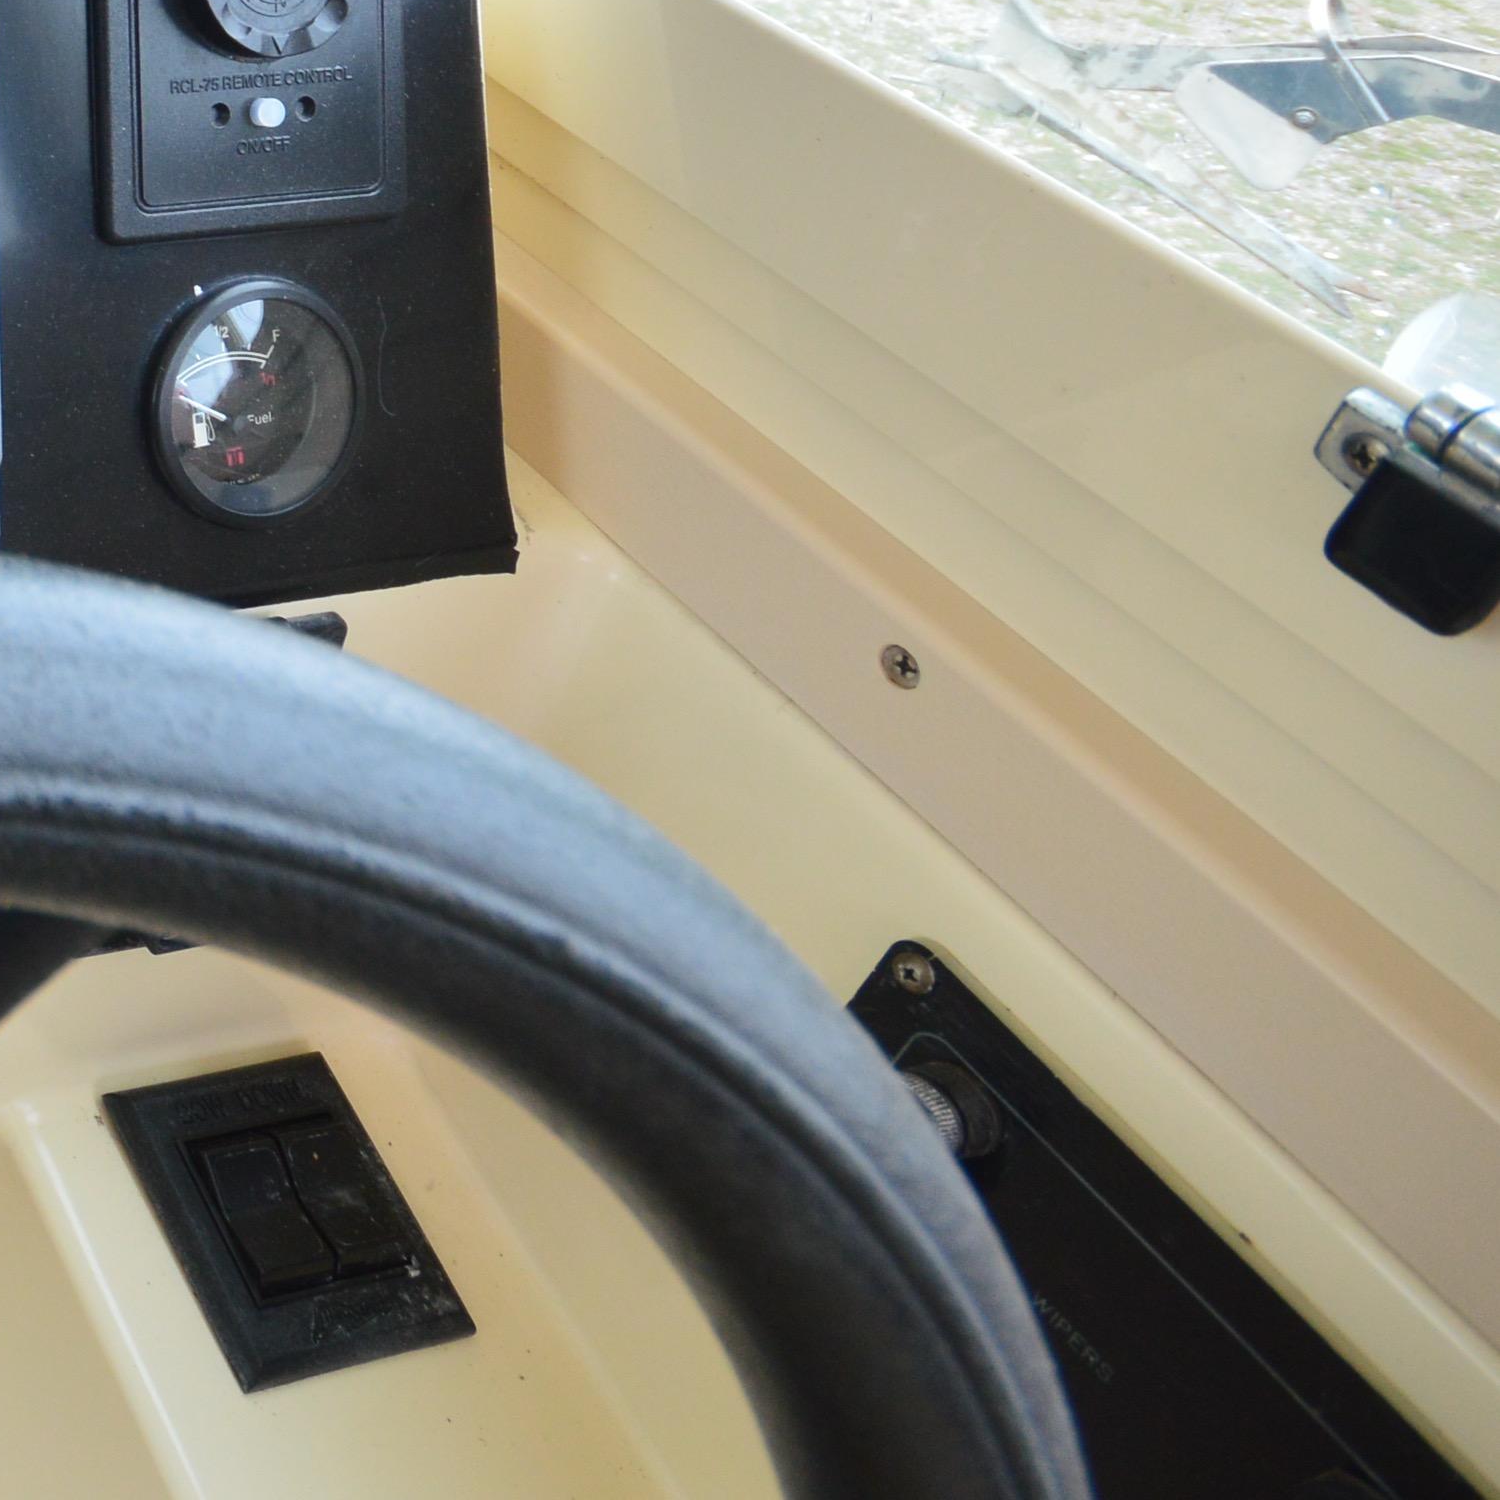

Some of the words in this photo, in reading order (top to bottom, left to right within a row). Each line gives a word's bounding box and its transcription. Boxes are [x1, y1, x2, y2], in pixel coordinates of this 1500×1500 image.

[169, 77, 220, 95] RCL-75
[222, 72, 281, 91] REMOTE
[284, 65, 353, 86] CONTROL
[236, 136, 291, 156] ON/OFF
[271, 328, 281, 343] F
